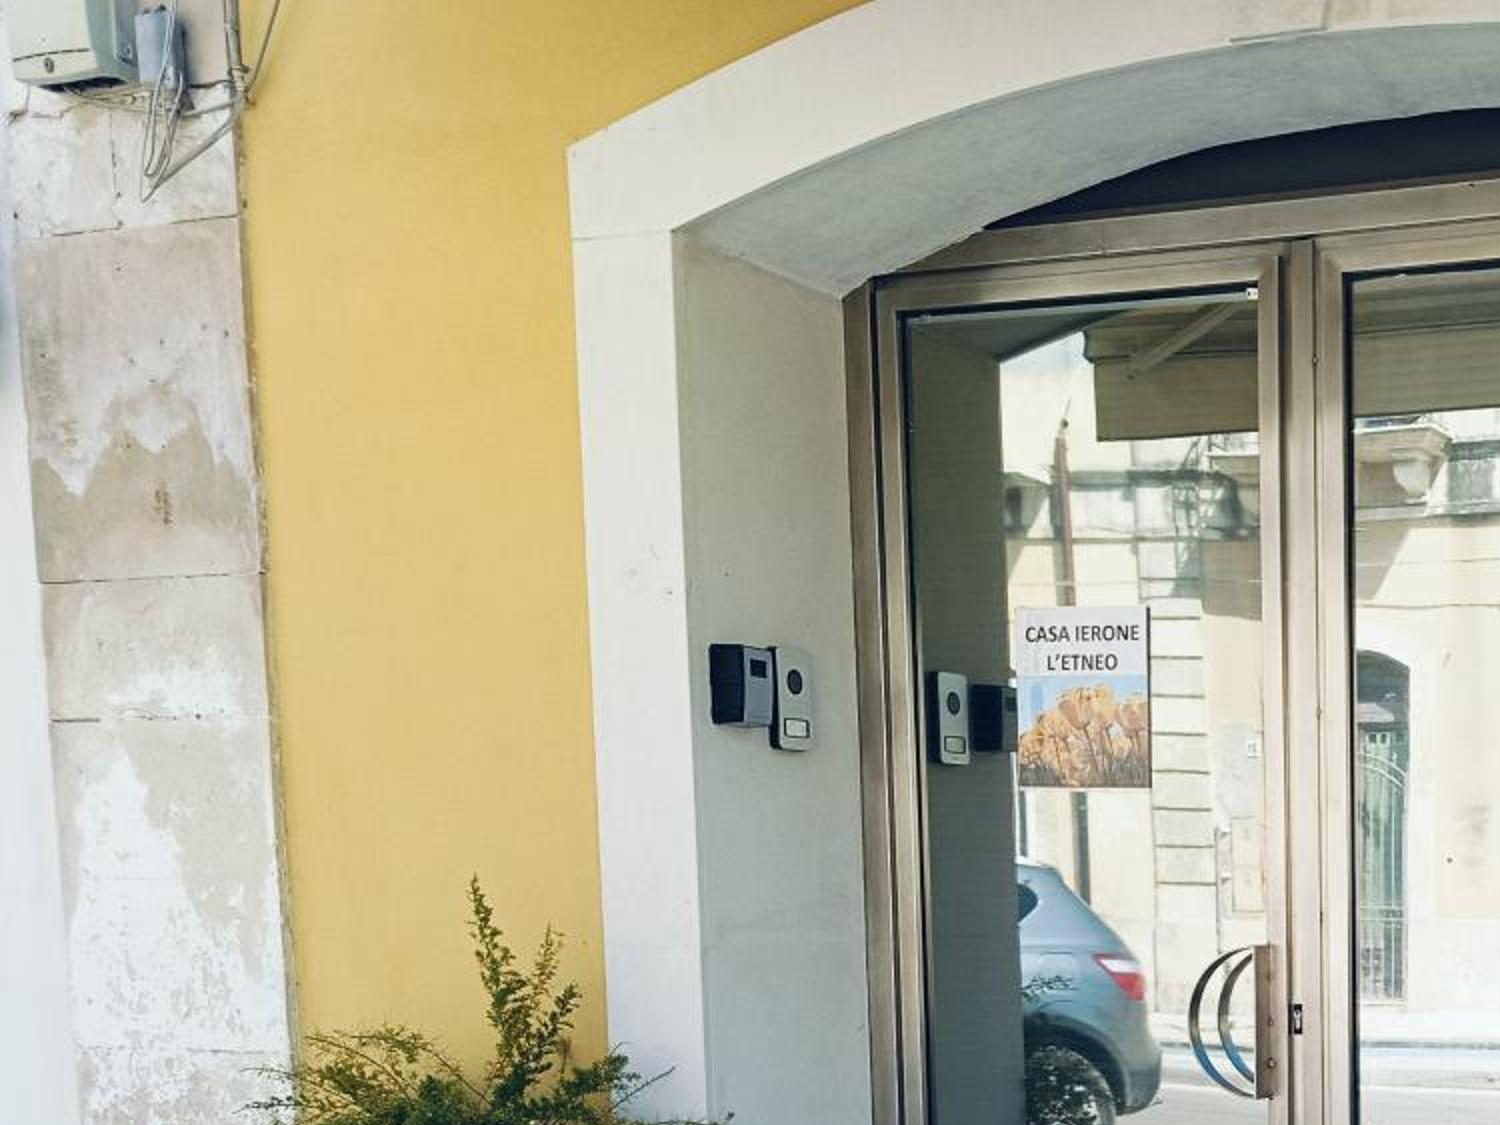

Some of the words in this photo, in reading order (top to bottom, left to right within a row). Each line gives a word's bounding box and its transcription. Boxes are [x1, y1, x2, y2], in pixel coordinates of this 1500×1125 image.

[1025, 625, 1071, 643] CASA
[1075, 625, 1140, 642] IERONE
[1047, 653, 1119, 671] L'ETNEO
